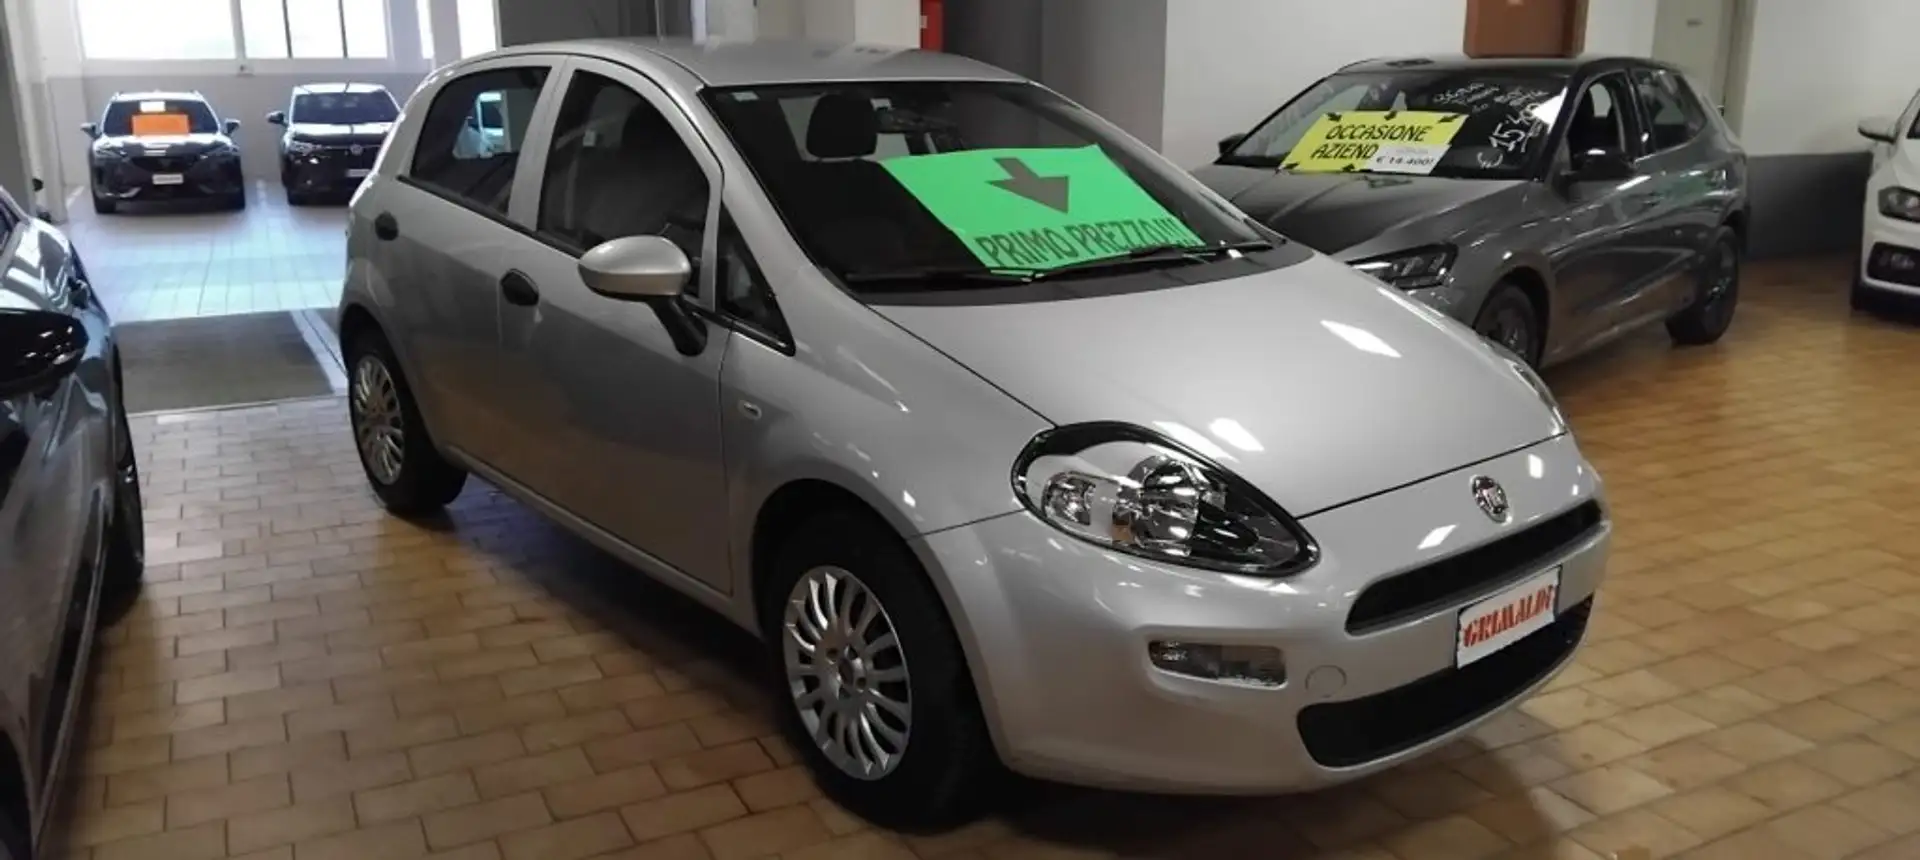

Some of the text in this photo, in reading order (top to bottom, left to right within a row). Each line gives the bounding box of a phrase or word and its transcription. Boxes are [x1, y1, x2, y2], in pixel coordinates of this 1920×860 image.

[1325, 123, 1433, 142] OCCASIONE
[974, 227, 1080, 266] PRIMO
[1463, 584, 1554, 647] GRIMALDI
